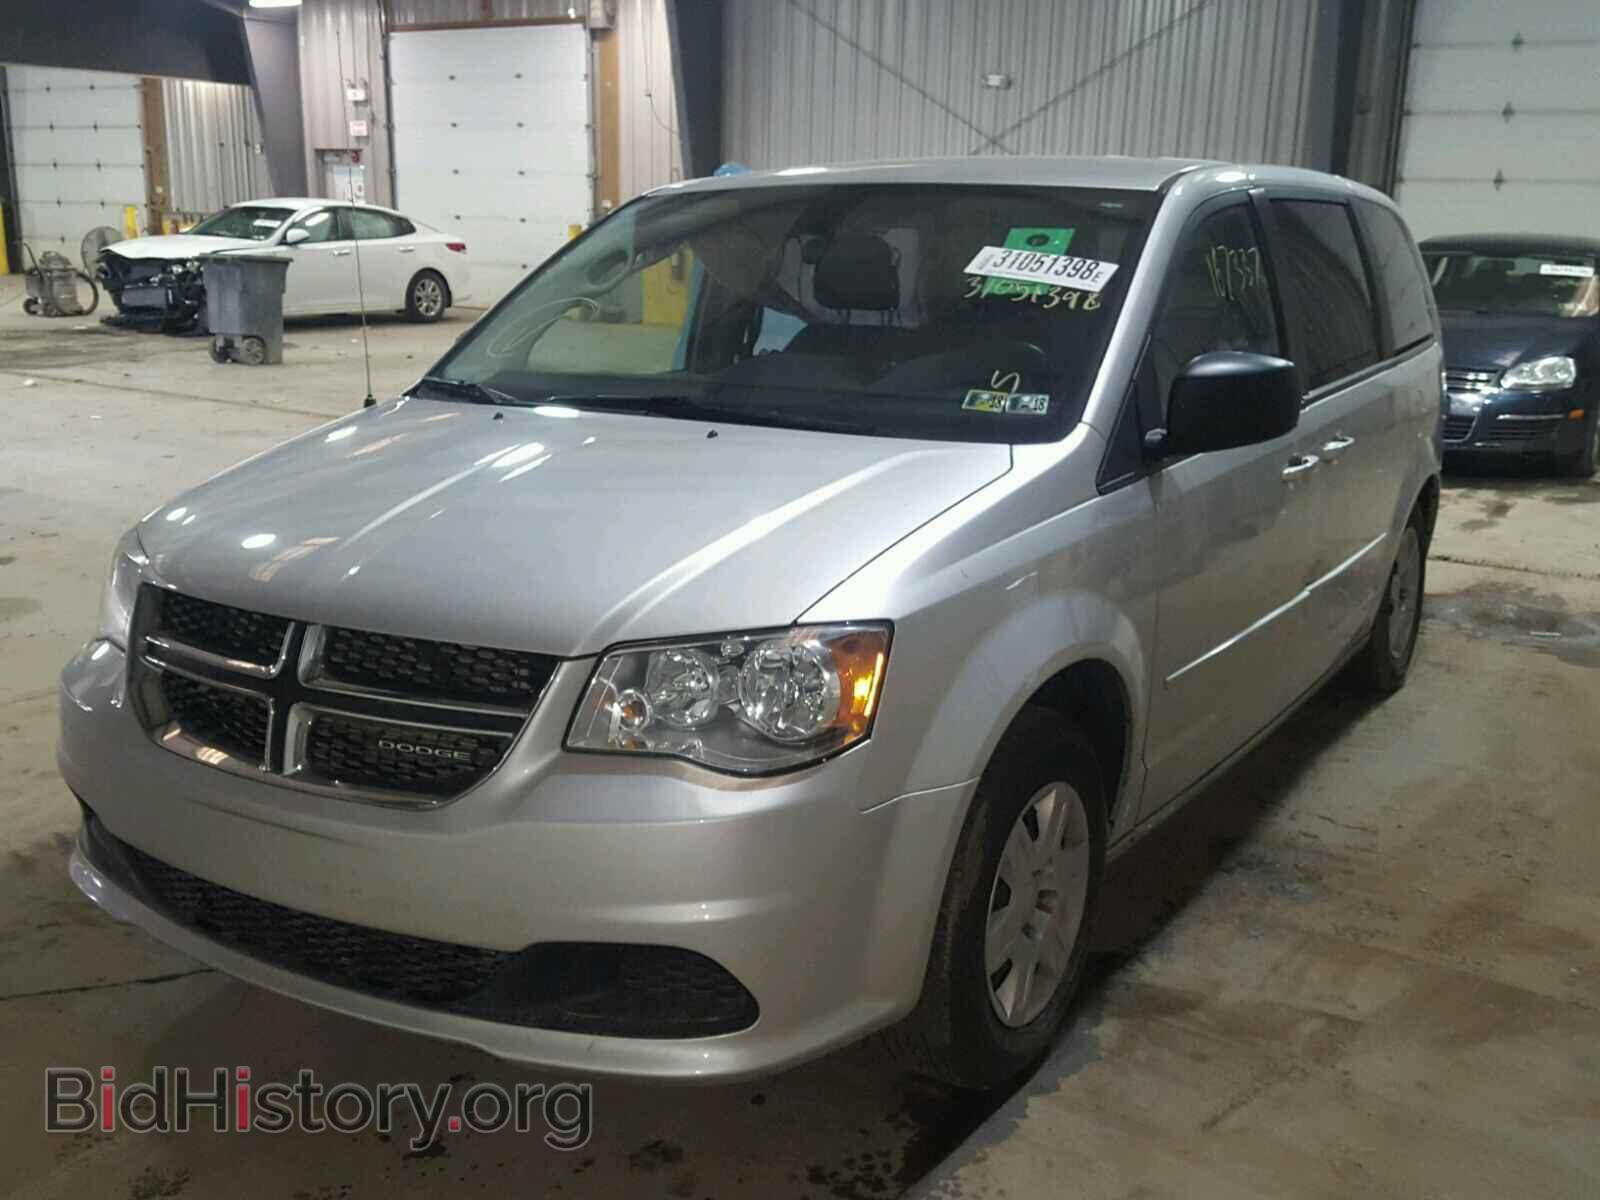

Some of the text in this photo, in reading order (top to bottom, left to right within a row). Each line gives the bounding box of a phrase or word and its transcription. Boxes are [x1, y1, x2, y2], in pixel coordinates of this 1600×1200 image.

[992, 250, 1100, 281] 31051398
[963, 275, 1101, 310] 31051398
[378, 740, 472, 761] DODGE
